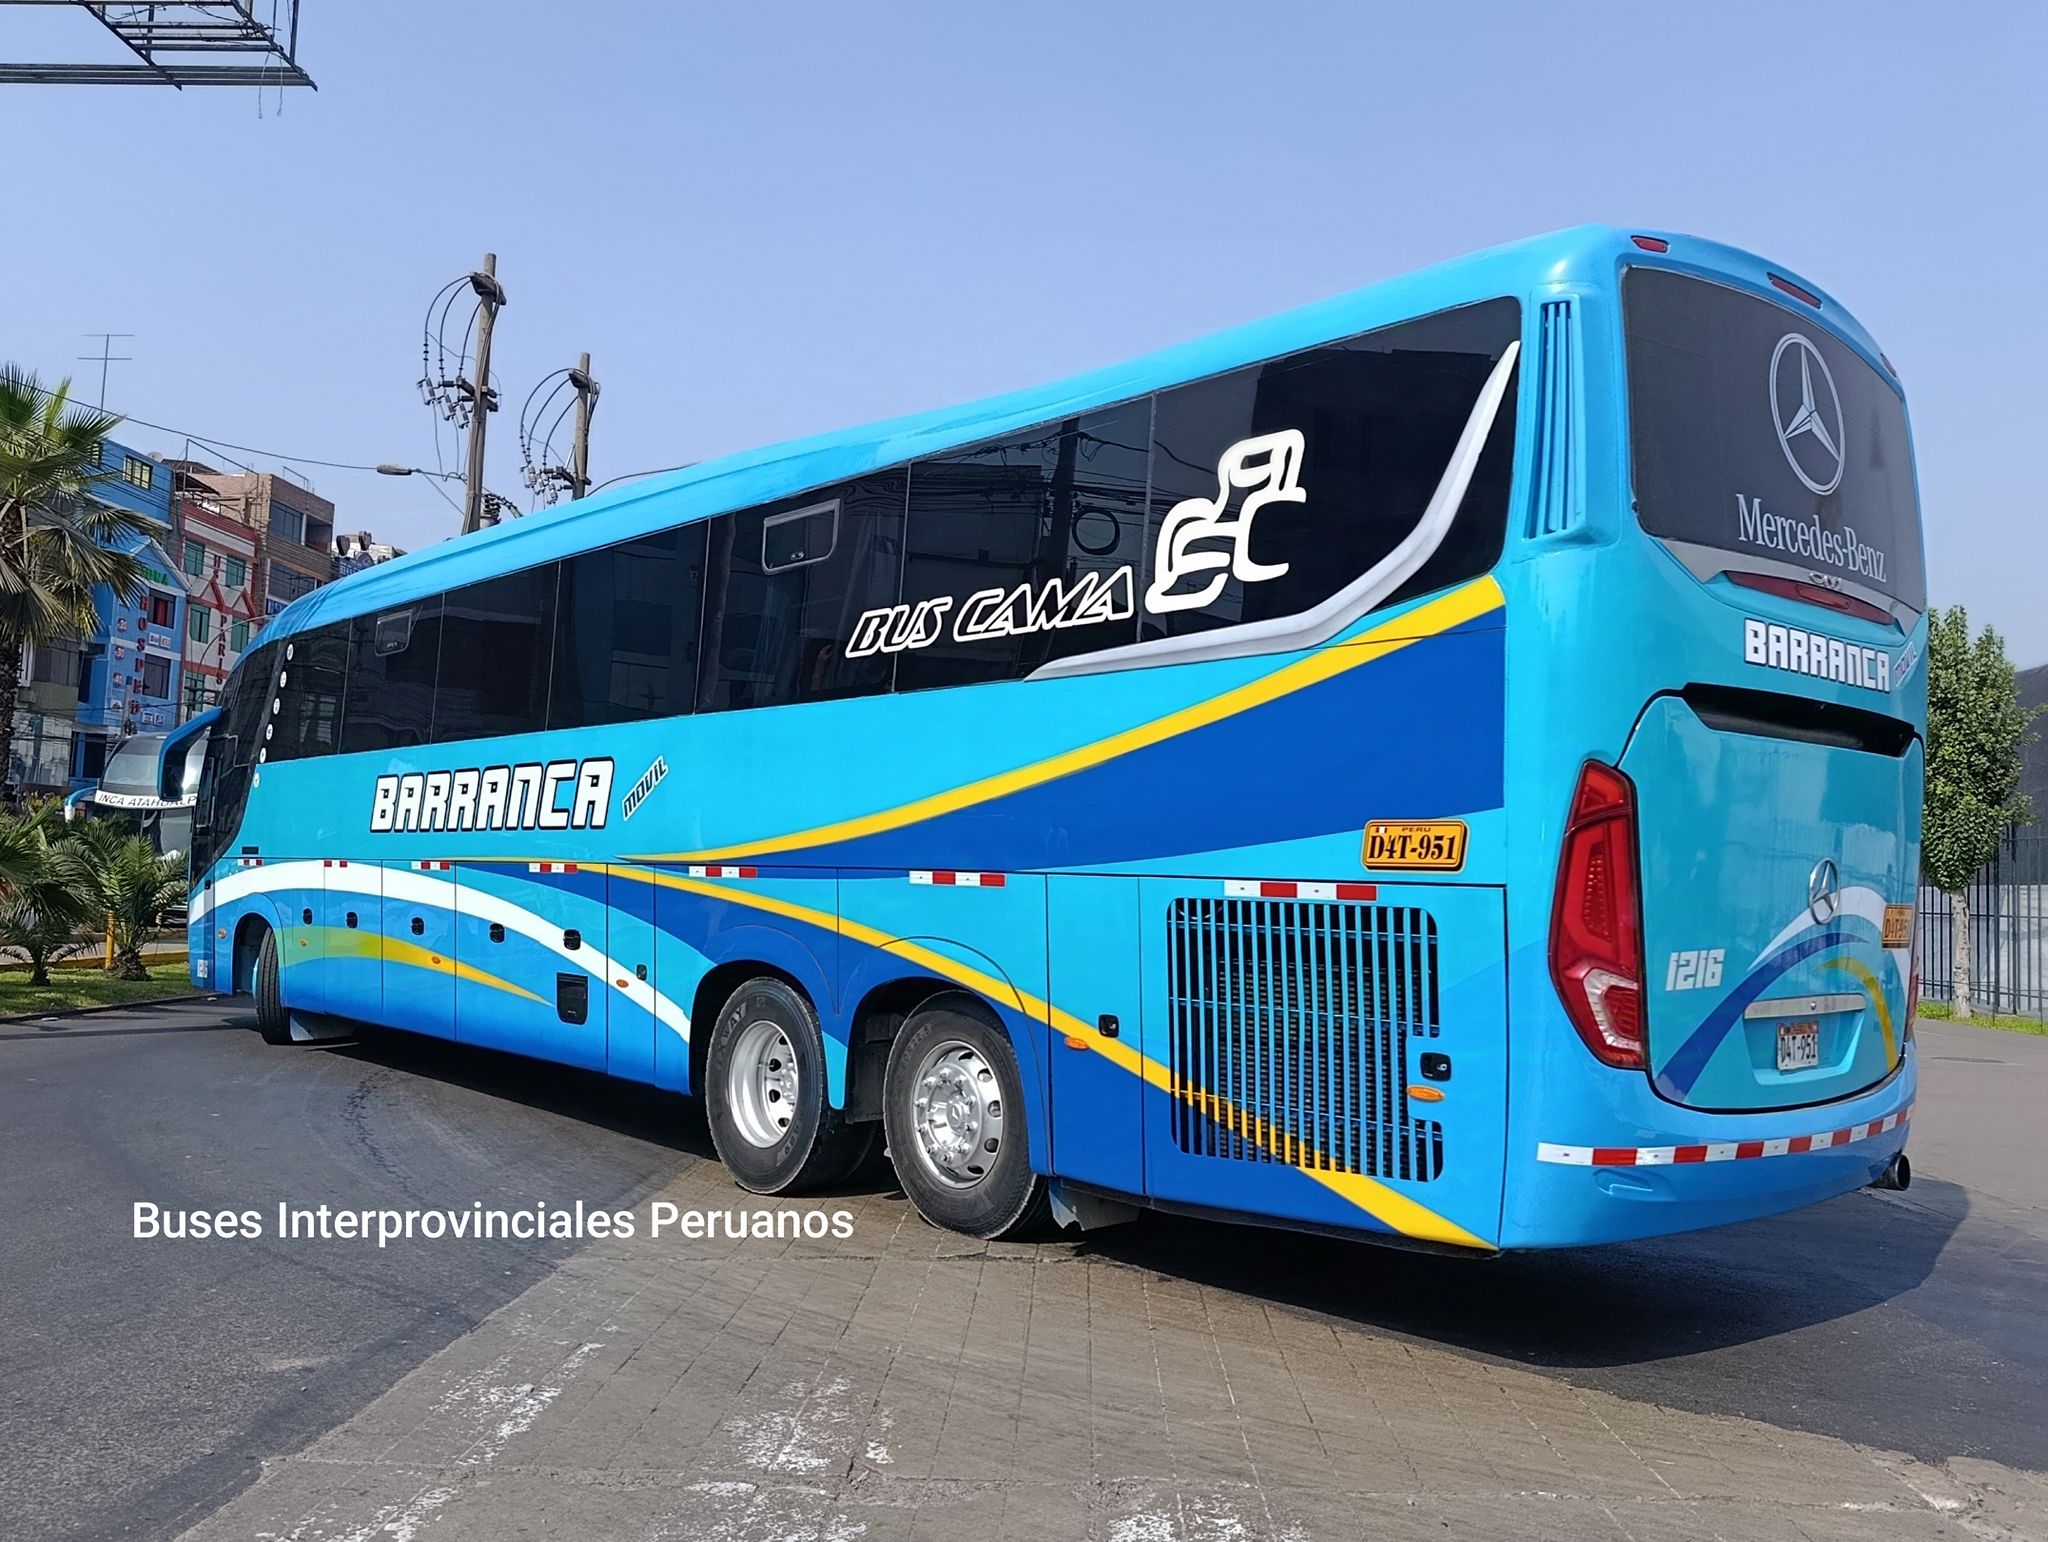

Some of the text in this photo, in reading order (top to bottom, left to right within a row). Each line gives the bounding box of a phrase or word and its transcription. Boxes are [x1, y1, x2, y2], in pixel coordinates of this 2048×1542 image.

[1735, 493, 1887, 583] Mercedes-Benz
[845, 565, 1135, 659] BUS CAMA
[1744, 617, 1891, 693] BARRANCA
[98, 794, 125, 806] INCA
[370, 755, 668, 833] BARRANCA MOVIL
[1367, 834, 1457, 860] D4T-951
[1665, 948, 1725, 992] 1216
[1780, 1033, 1816, 1063] D4T-951
